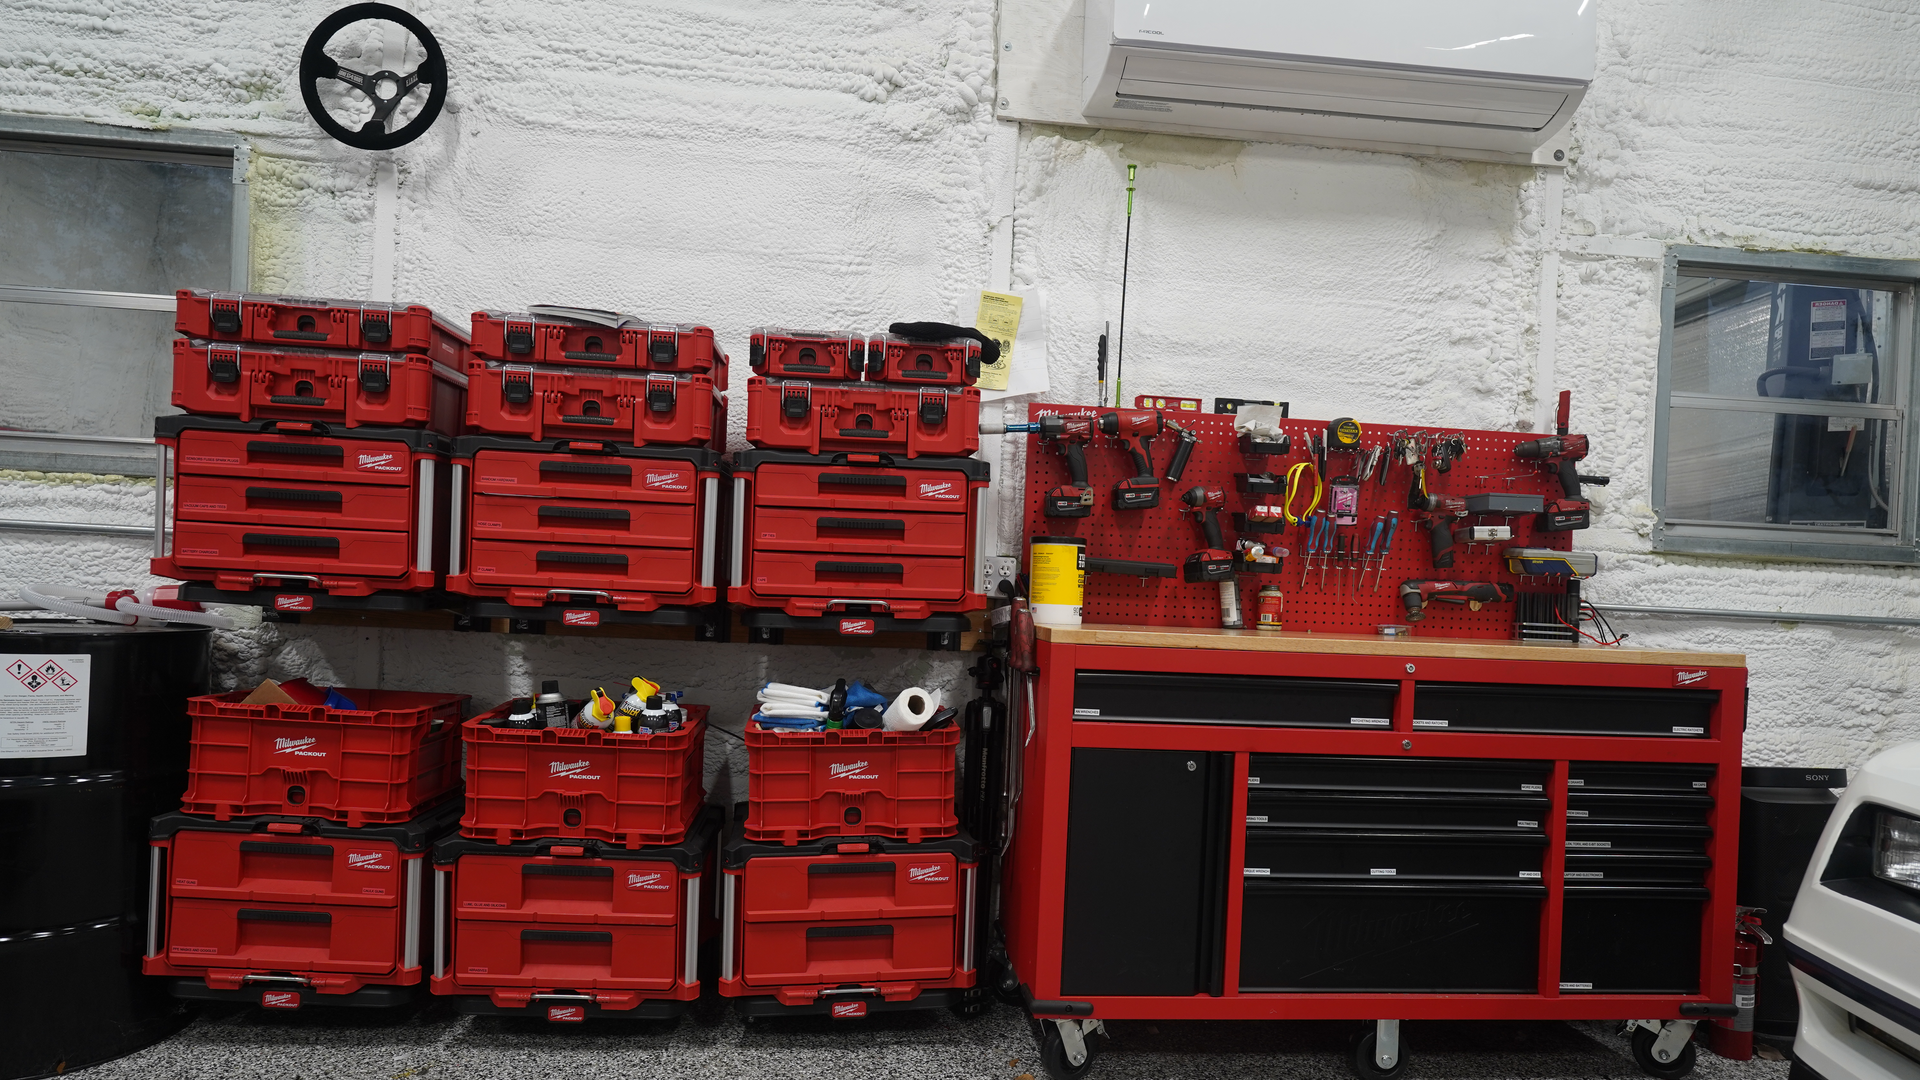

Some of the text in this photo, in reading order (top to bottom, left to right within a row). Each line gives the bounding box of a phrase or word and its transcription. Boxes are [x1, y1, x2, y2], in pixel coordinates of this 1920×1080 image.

[358, 453, 392, 465] Milwaukee
[645, 472, 679, 484] Milwaukee
[919, 482, 952, 494] Milwaukee
[277, 596, 304, 606] Milwaukee
[565, 612, 591, 620] Milwaukee
[842, 621, 866, 629] Milwaukee
[1676, 670, 1707, 682] Milwaukee
[274, 736, 316, 750] Milwaukee
[548, 760, 590, 774] Milwaukee
[829, 760, 869, 775] Milwaukee
[348, 852, 382, 864] Milwaukee
[908, 865, 941, 877] Milwaukee
[627, 873, 661, 884] Milwaukee
